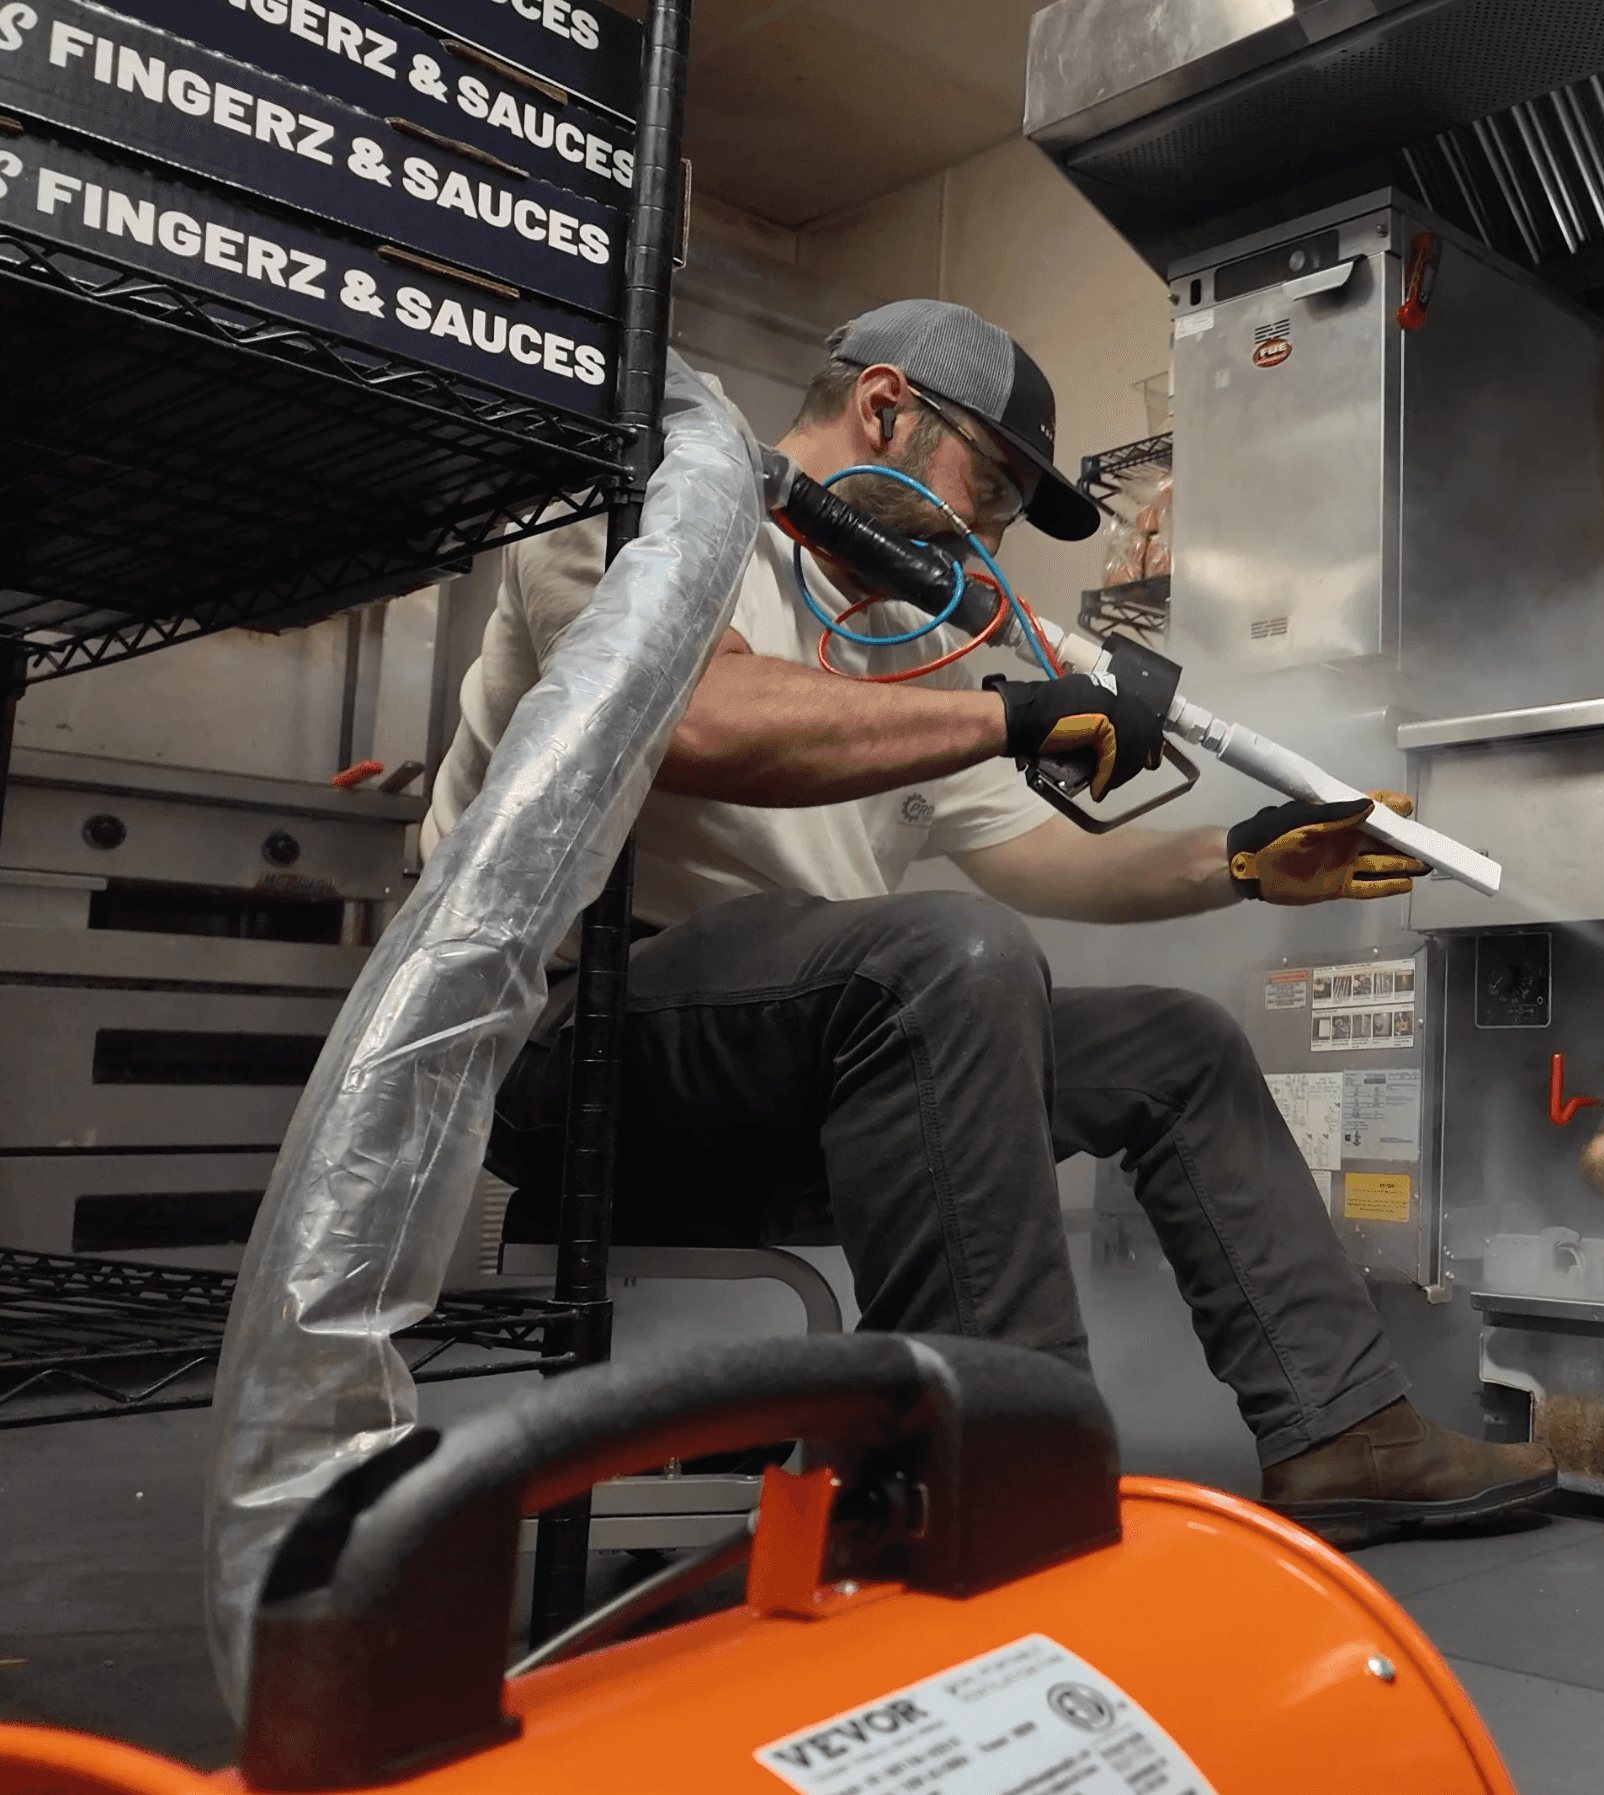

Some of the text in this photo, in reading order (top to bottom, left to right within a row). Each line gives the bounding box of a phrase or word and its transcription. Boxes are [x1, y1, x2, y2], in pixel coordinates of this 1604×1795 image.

[49, 20, 335, 166] FINGERZ
[348, 137, 393, 188] &
[402, 156, 611, 265] SAUCES
[409, 53, 448, 104] &
[456, 75, 635, 189] SAUCES
[36, 167, 327, 300] FINGERZ
[339, 269, 386, 319] &
[395, 286, 607, 386] SAUCES
[771, 1699, 929, 1769] VEVOR
